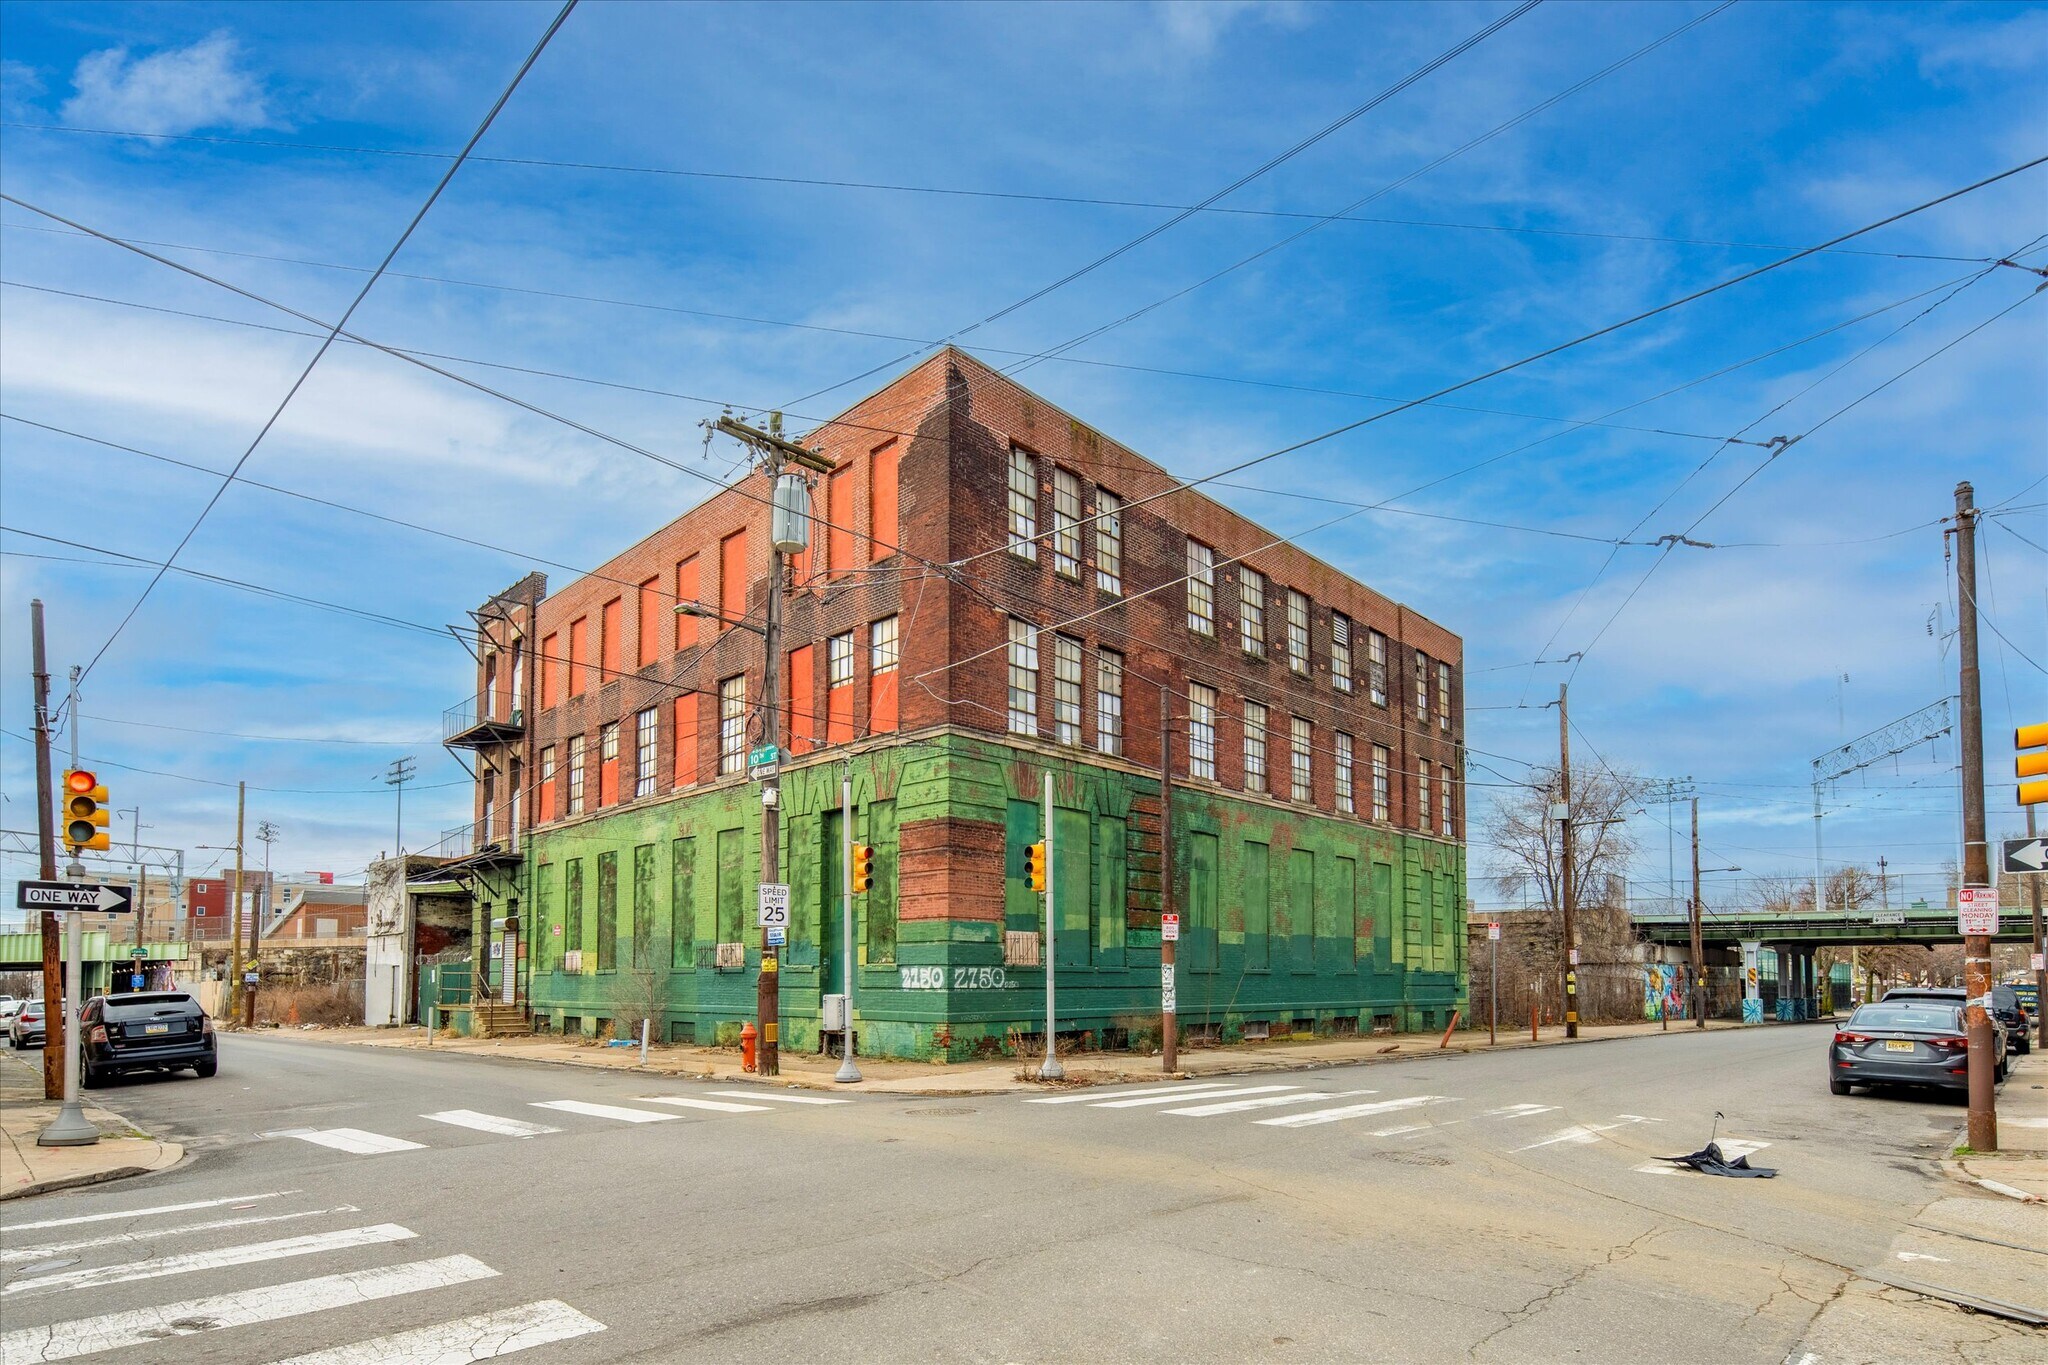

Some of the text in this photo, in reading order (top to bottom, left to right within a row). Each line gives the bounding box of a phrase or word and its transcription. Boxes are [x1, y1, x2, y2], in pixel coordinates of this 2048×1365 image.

[770, 752, 778, 760] ST
[30, 889, 99, 904] ONE WAY
[762, 888, 787, 896] SPEED
[1960, 891, 1973, 901] NO
[764, 897, 784, 905] LIMIT
[764, 906, 785, 922] 25
[954, 967, 1005, 988] 2750
